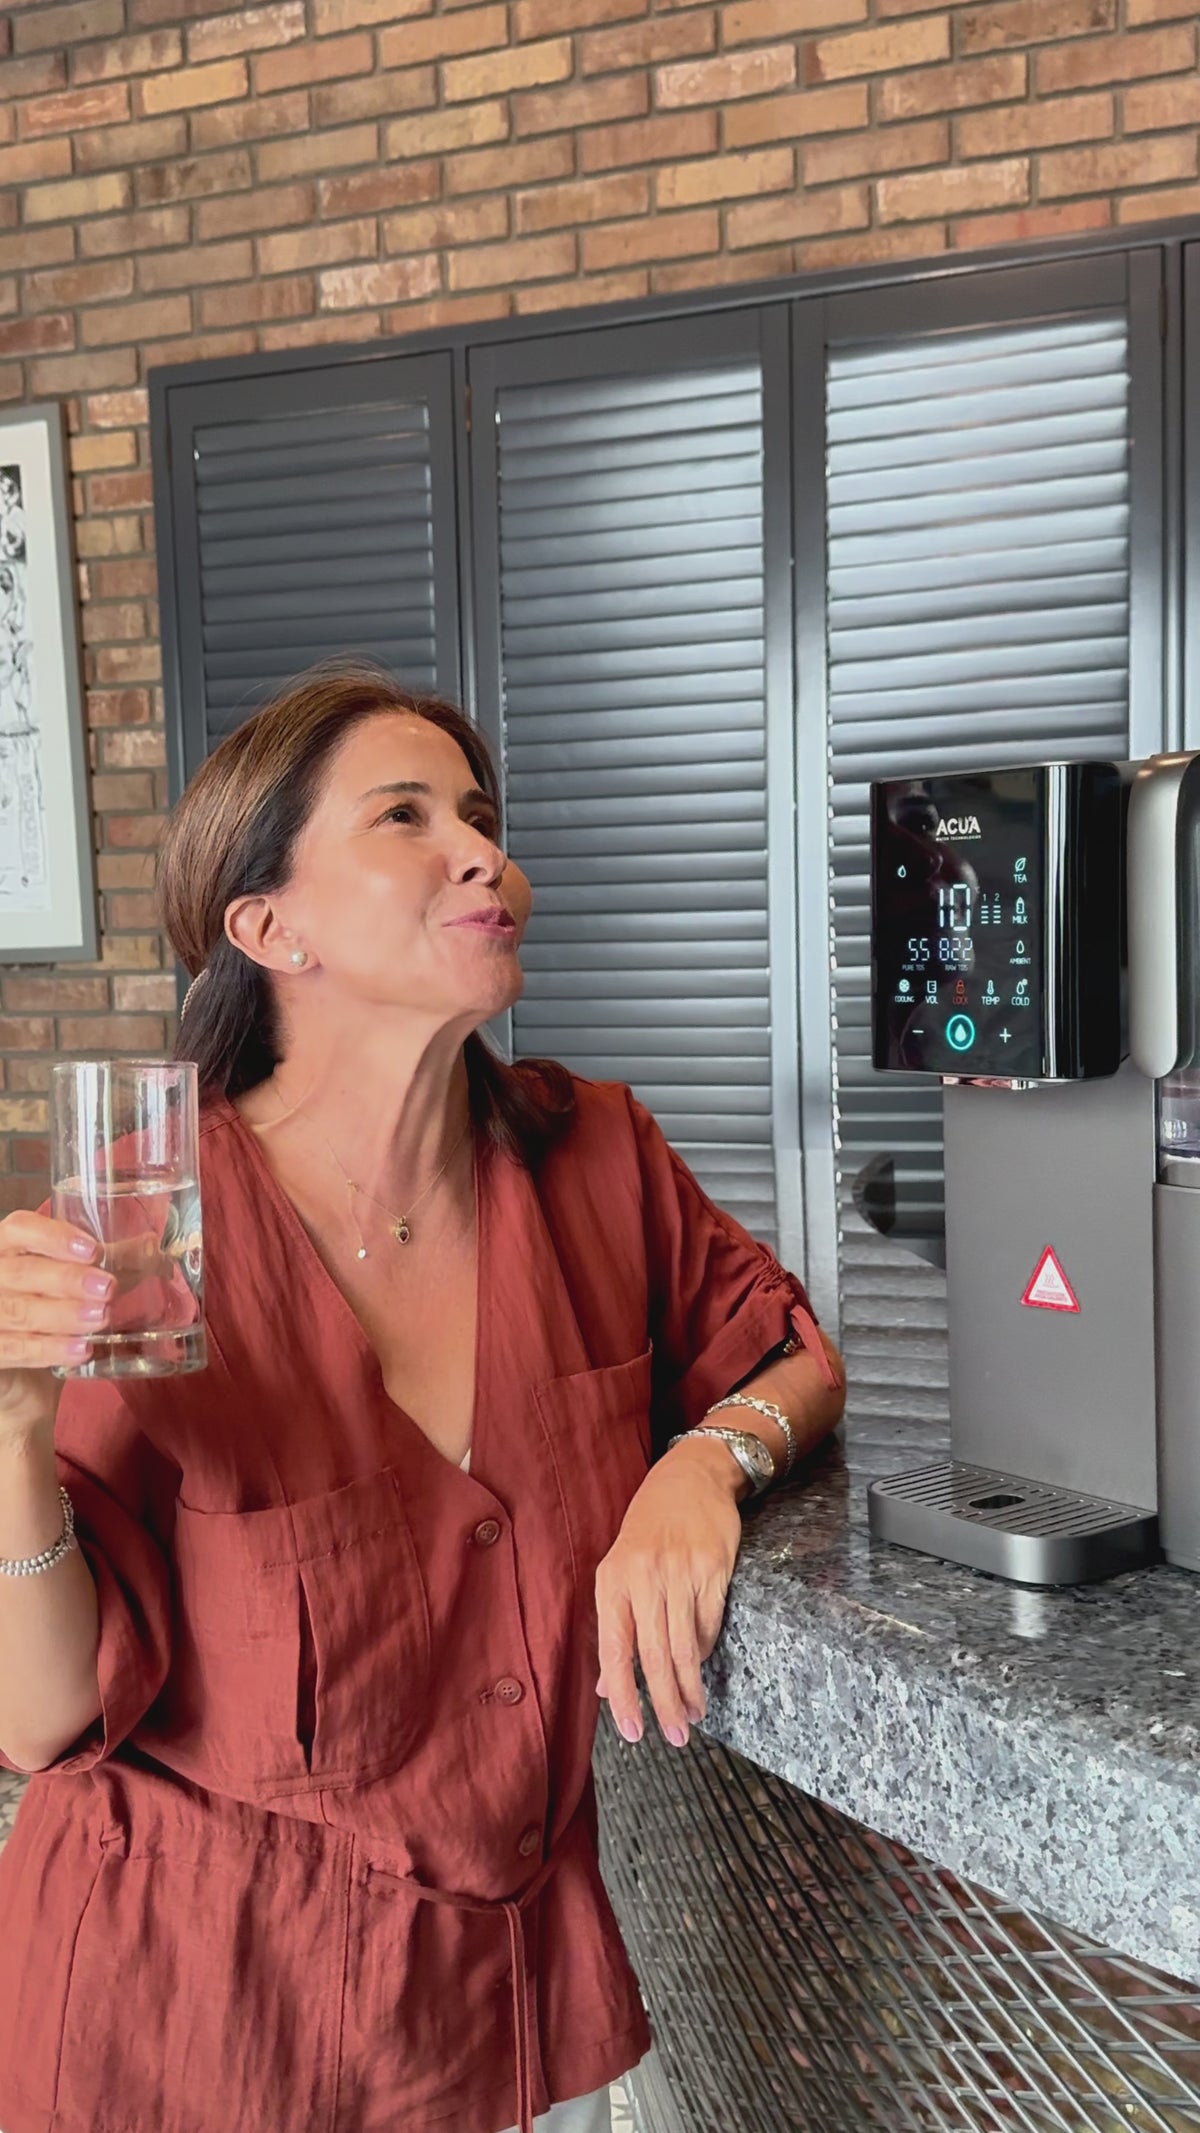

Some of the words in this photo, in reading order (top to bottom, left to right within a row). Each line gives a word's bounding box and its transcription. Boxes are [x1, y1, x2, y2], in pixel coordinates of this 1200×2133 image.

[1013, 873, 1028, 884] TEA
[982, 893, 987, 902] 1
[994, 892, 1001, 902] 2
[939, 884, 970, 931] 10
[1012, 915, 1028, 925] MILK
[908, 937, 930, 961] 55
[939, 937, 973, 961] 822
[925, 995, 939, 1005] VOL
[953, 996, 969, 1005] LOCK
[981, 996, 1001, 1006] TEMP
[1011, 996, 1031, 1006] COLD
